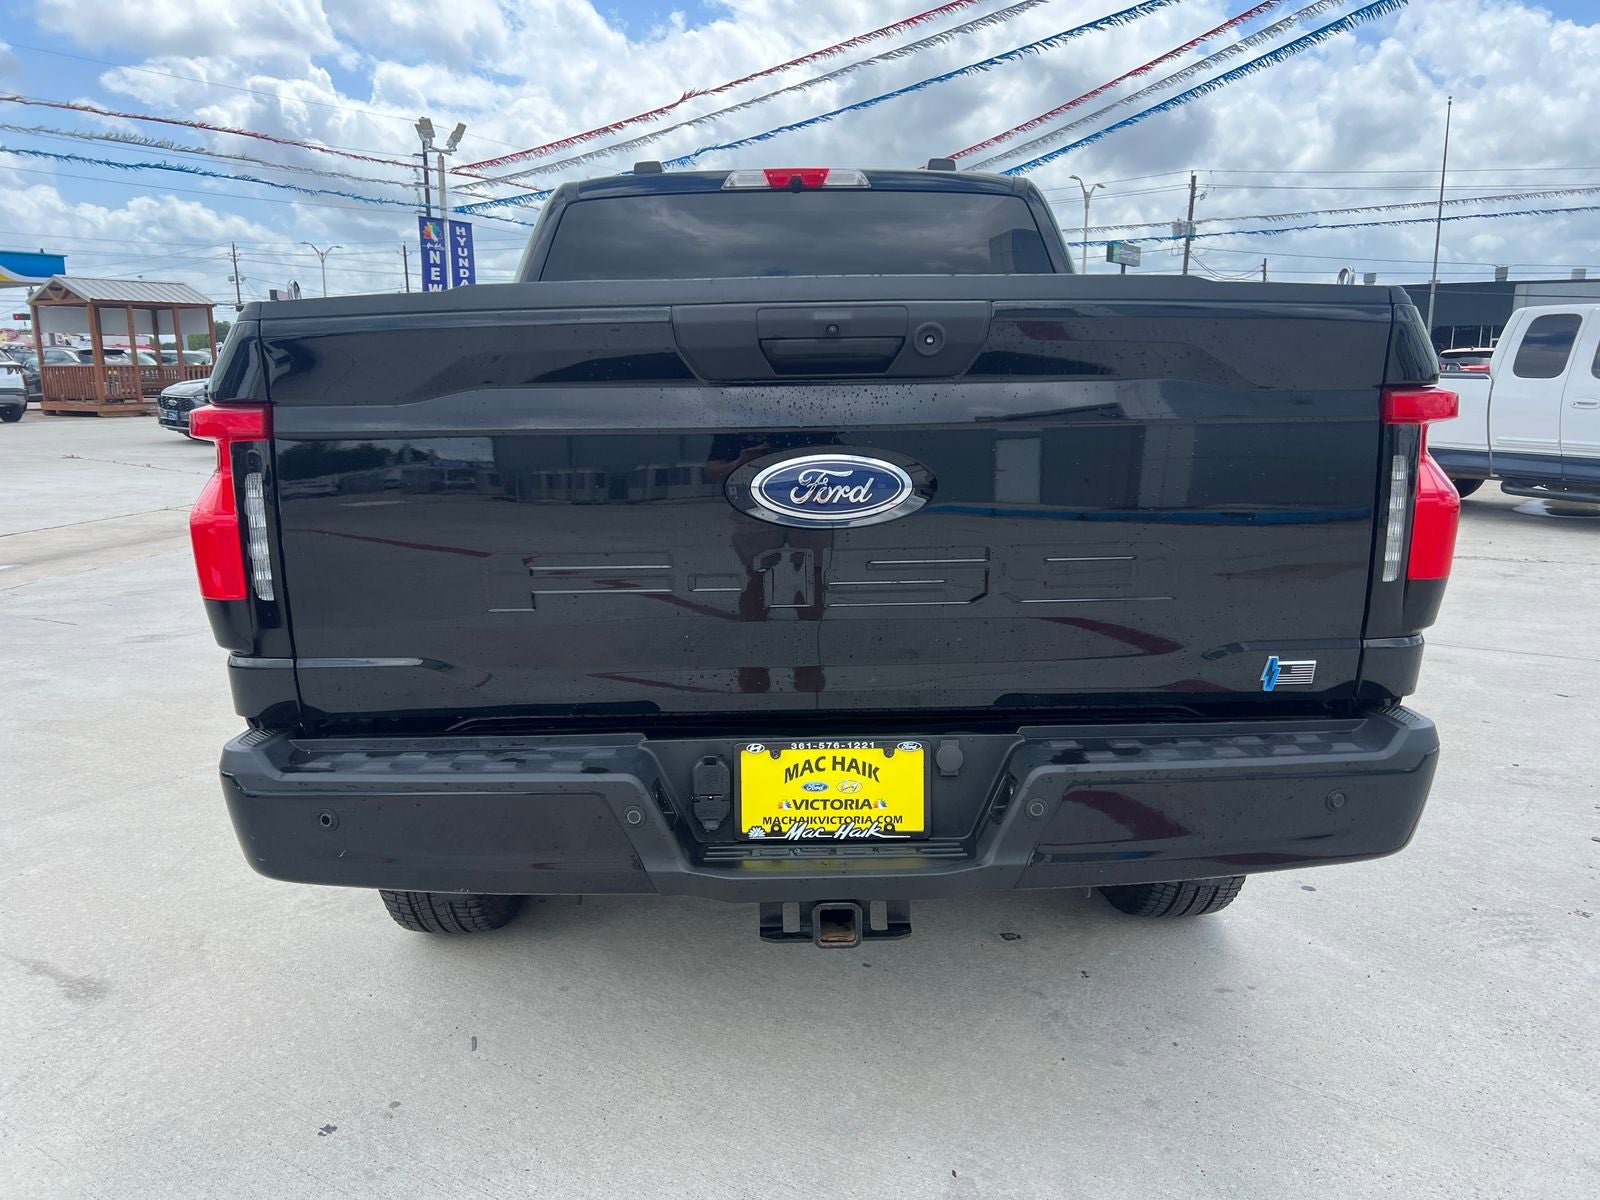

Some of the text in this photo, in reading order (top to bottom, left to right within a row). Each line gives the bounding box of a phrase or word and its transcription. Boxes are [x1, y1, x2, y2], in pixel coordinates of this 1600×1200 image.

[428, 250, 443, 292] NEW
[789, 468, 875, 505] Ford
[790, 741, 875, 750] 361-576-1221
[784, 755, 880, 784] MAC HAIK
[805, 782, 826, 791] Ford
[792, 798, 873, 811] VICTORIA
[762, 815, 903, 825] MACHAIKVICTORIA.COM
[784, 820, 886, 841] Mac Haik
